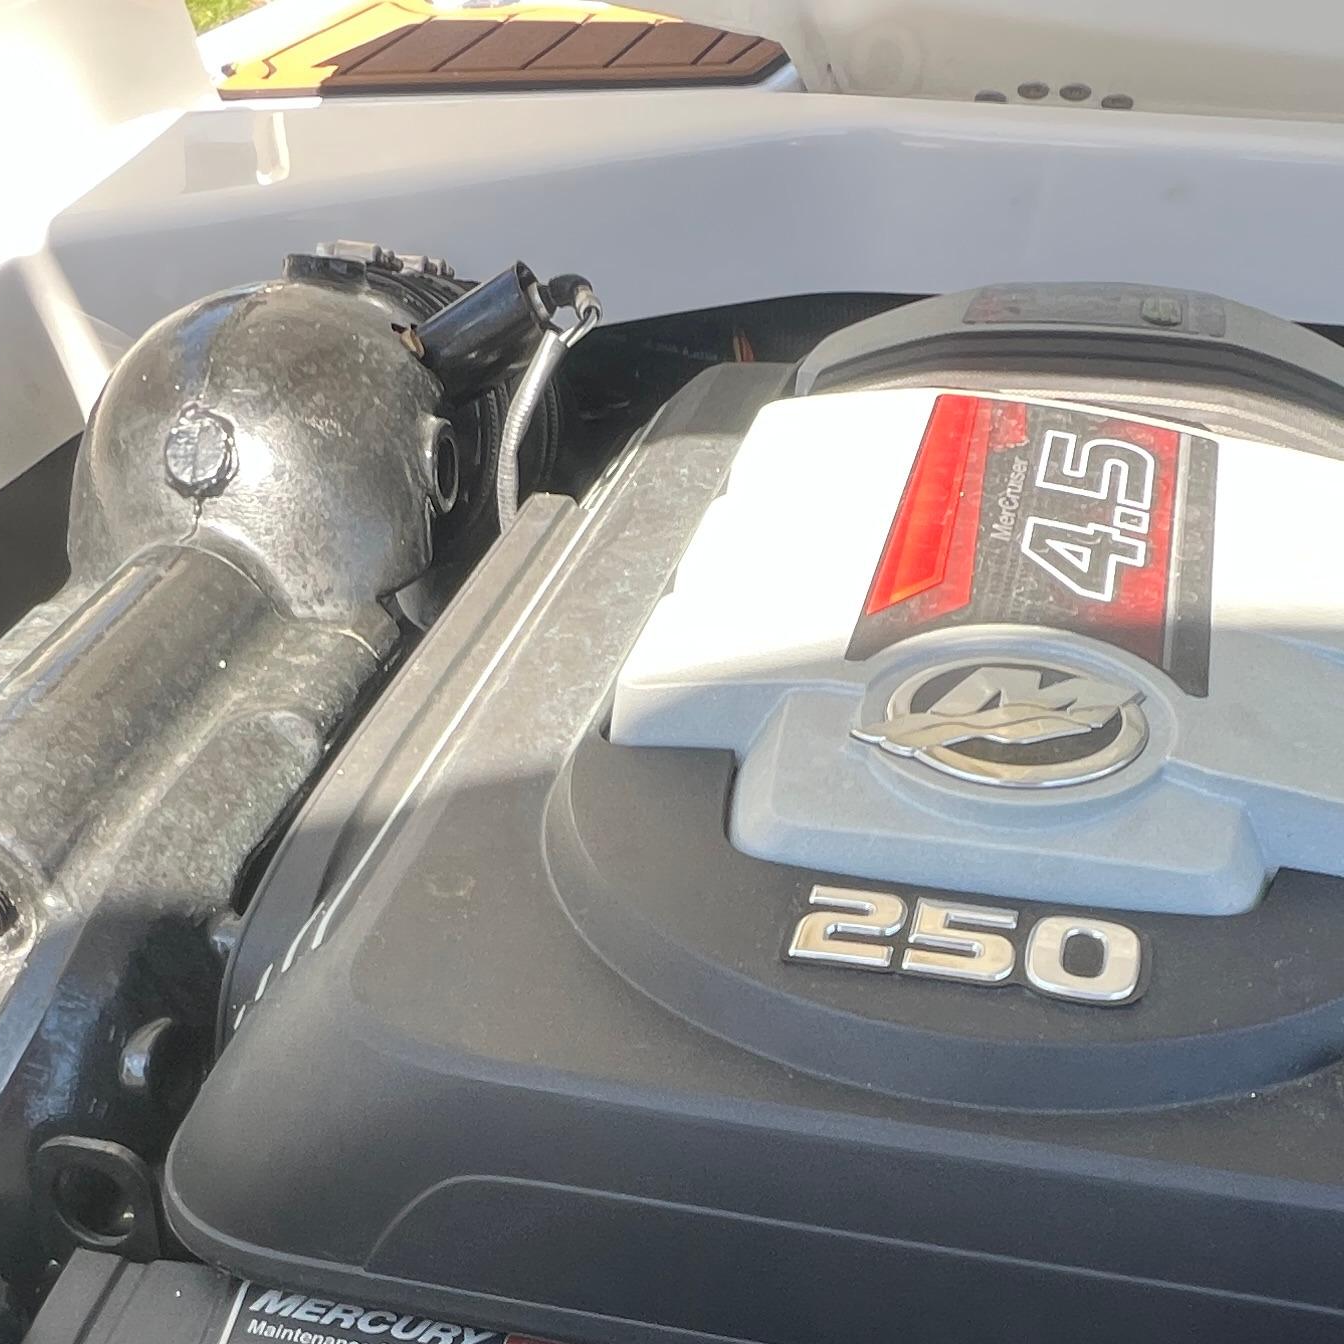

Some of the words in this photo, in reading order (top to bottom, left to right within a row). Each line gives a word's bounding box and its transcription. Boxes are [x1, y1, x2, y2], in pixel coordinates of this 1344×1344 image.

[991, 455, 1028, 541] MerCruiser
[1021, 429, 1155, 601] 4.5
[787, 884, 1142, 1002] 250
